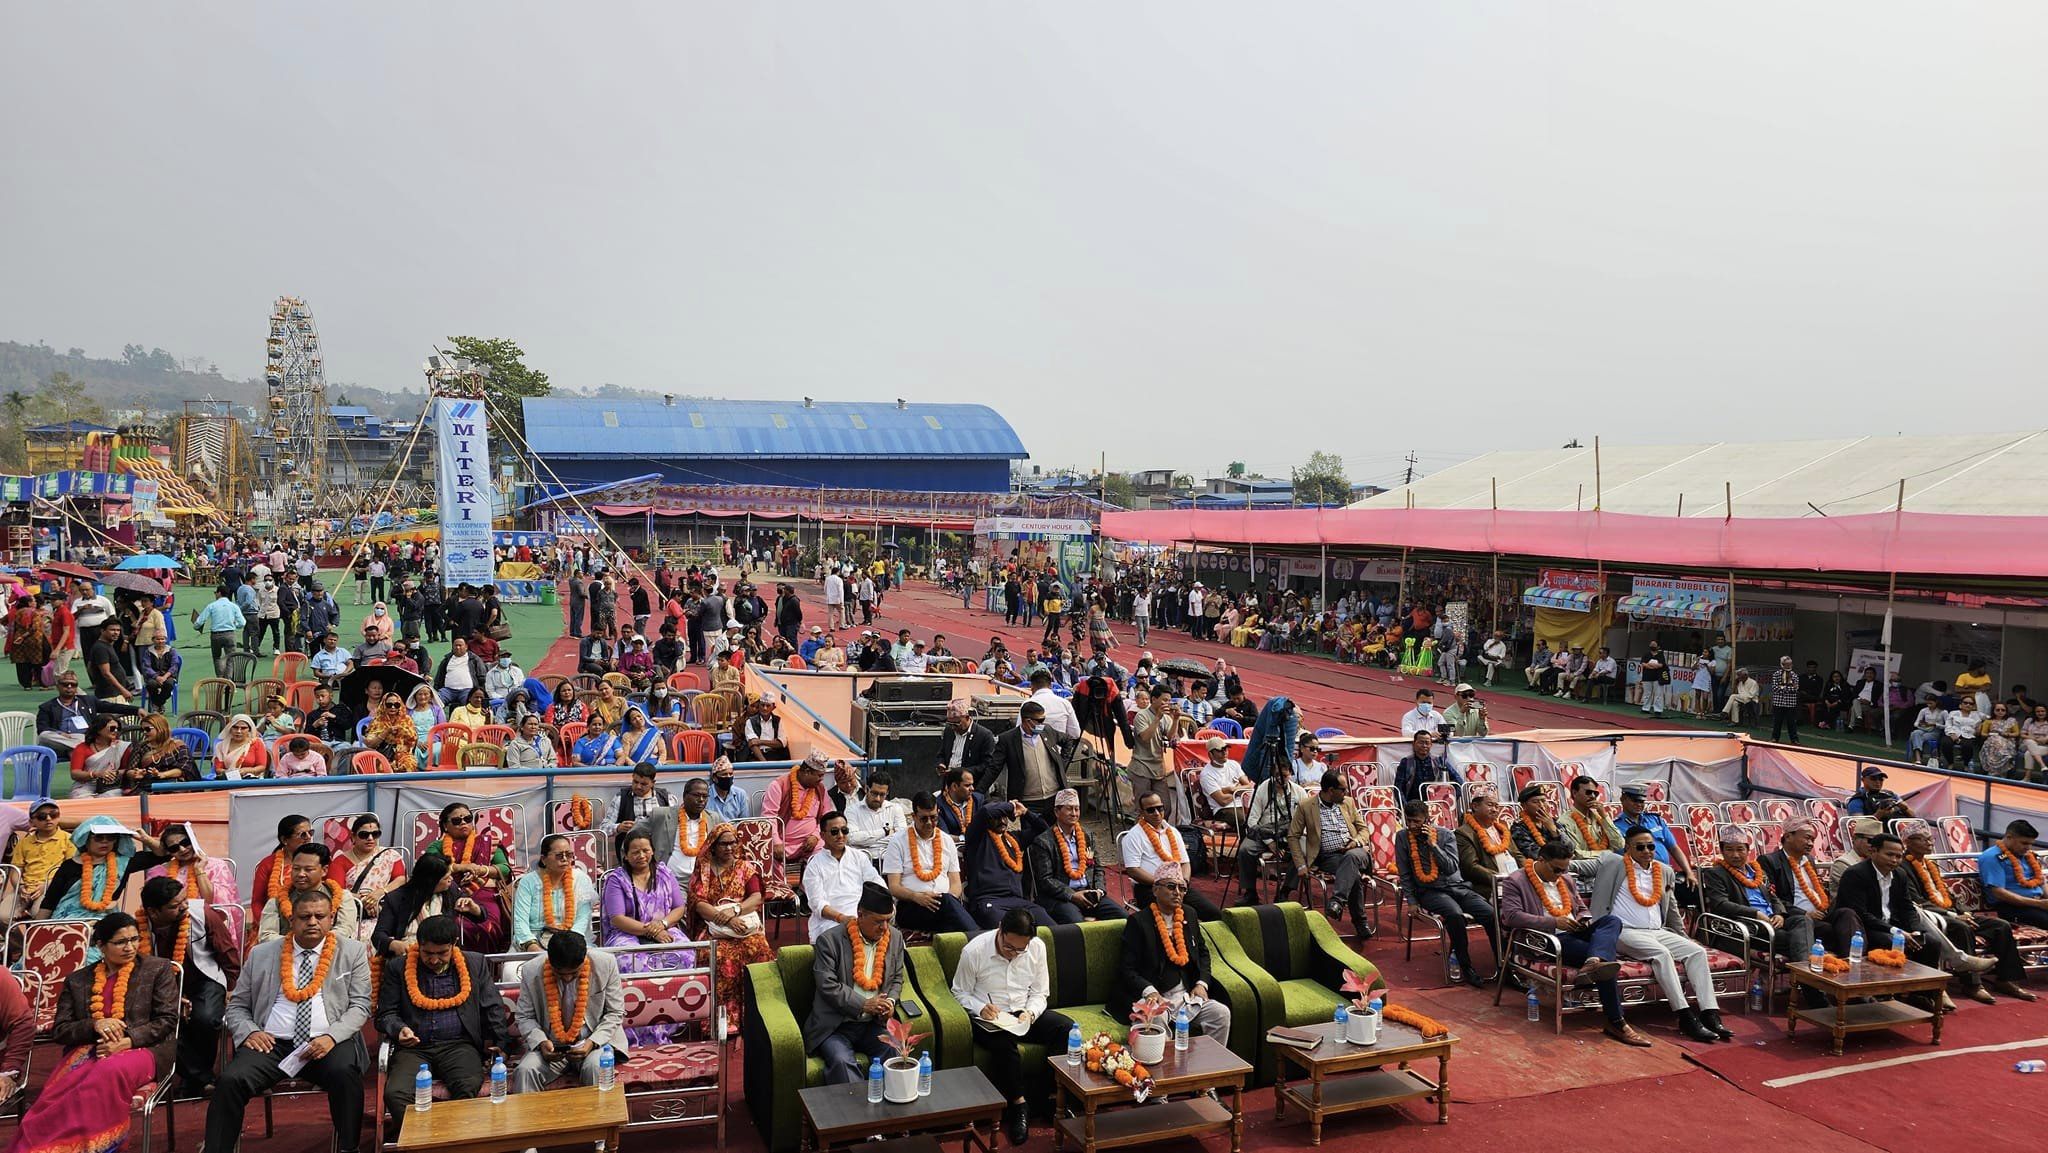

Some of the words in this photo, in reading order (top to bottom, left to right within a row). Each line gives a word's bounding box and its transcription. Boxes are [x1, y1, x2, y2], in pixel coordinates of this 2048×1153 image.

[452, 423, 476, 520] MITERI
[1635, 579, 1672, 589] DHARANE
[1675, 582, 1708, 592] BUBBLE
[1711, 584, 1726, 593] TEA
[1673, 670, 1697, 683] BUBB
